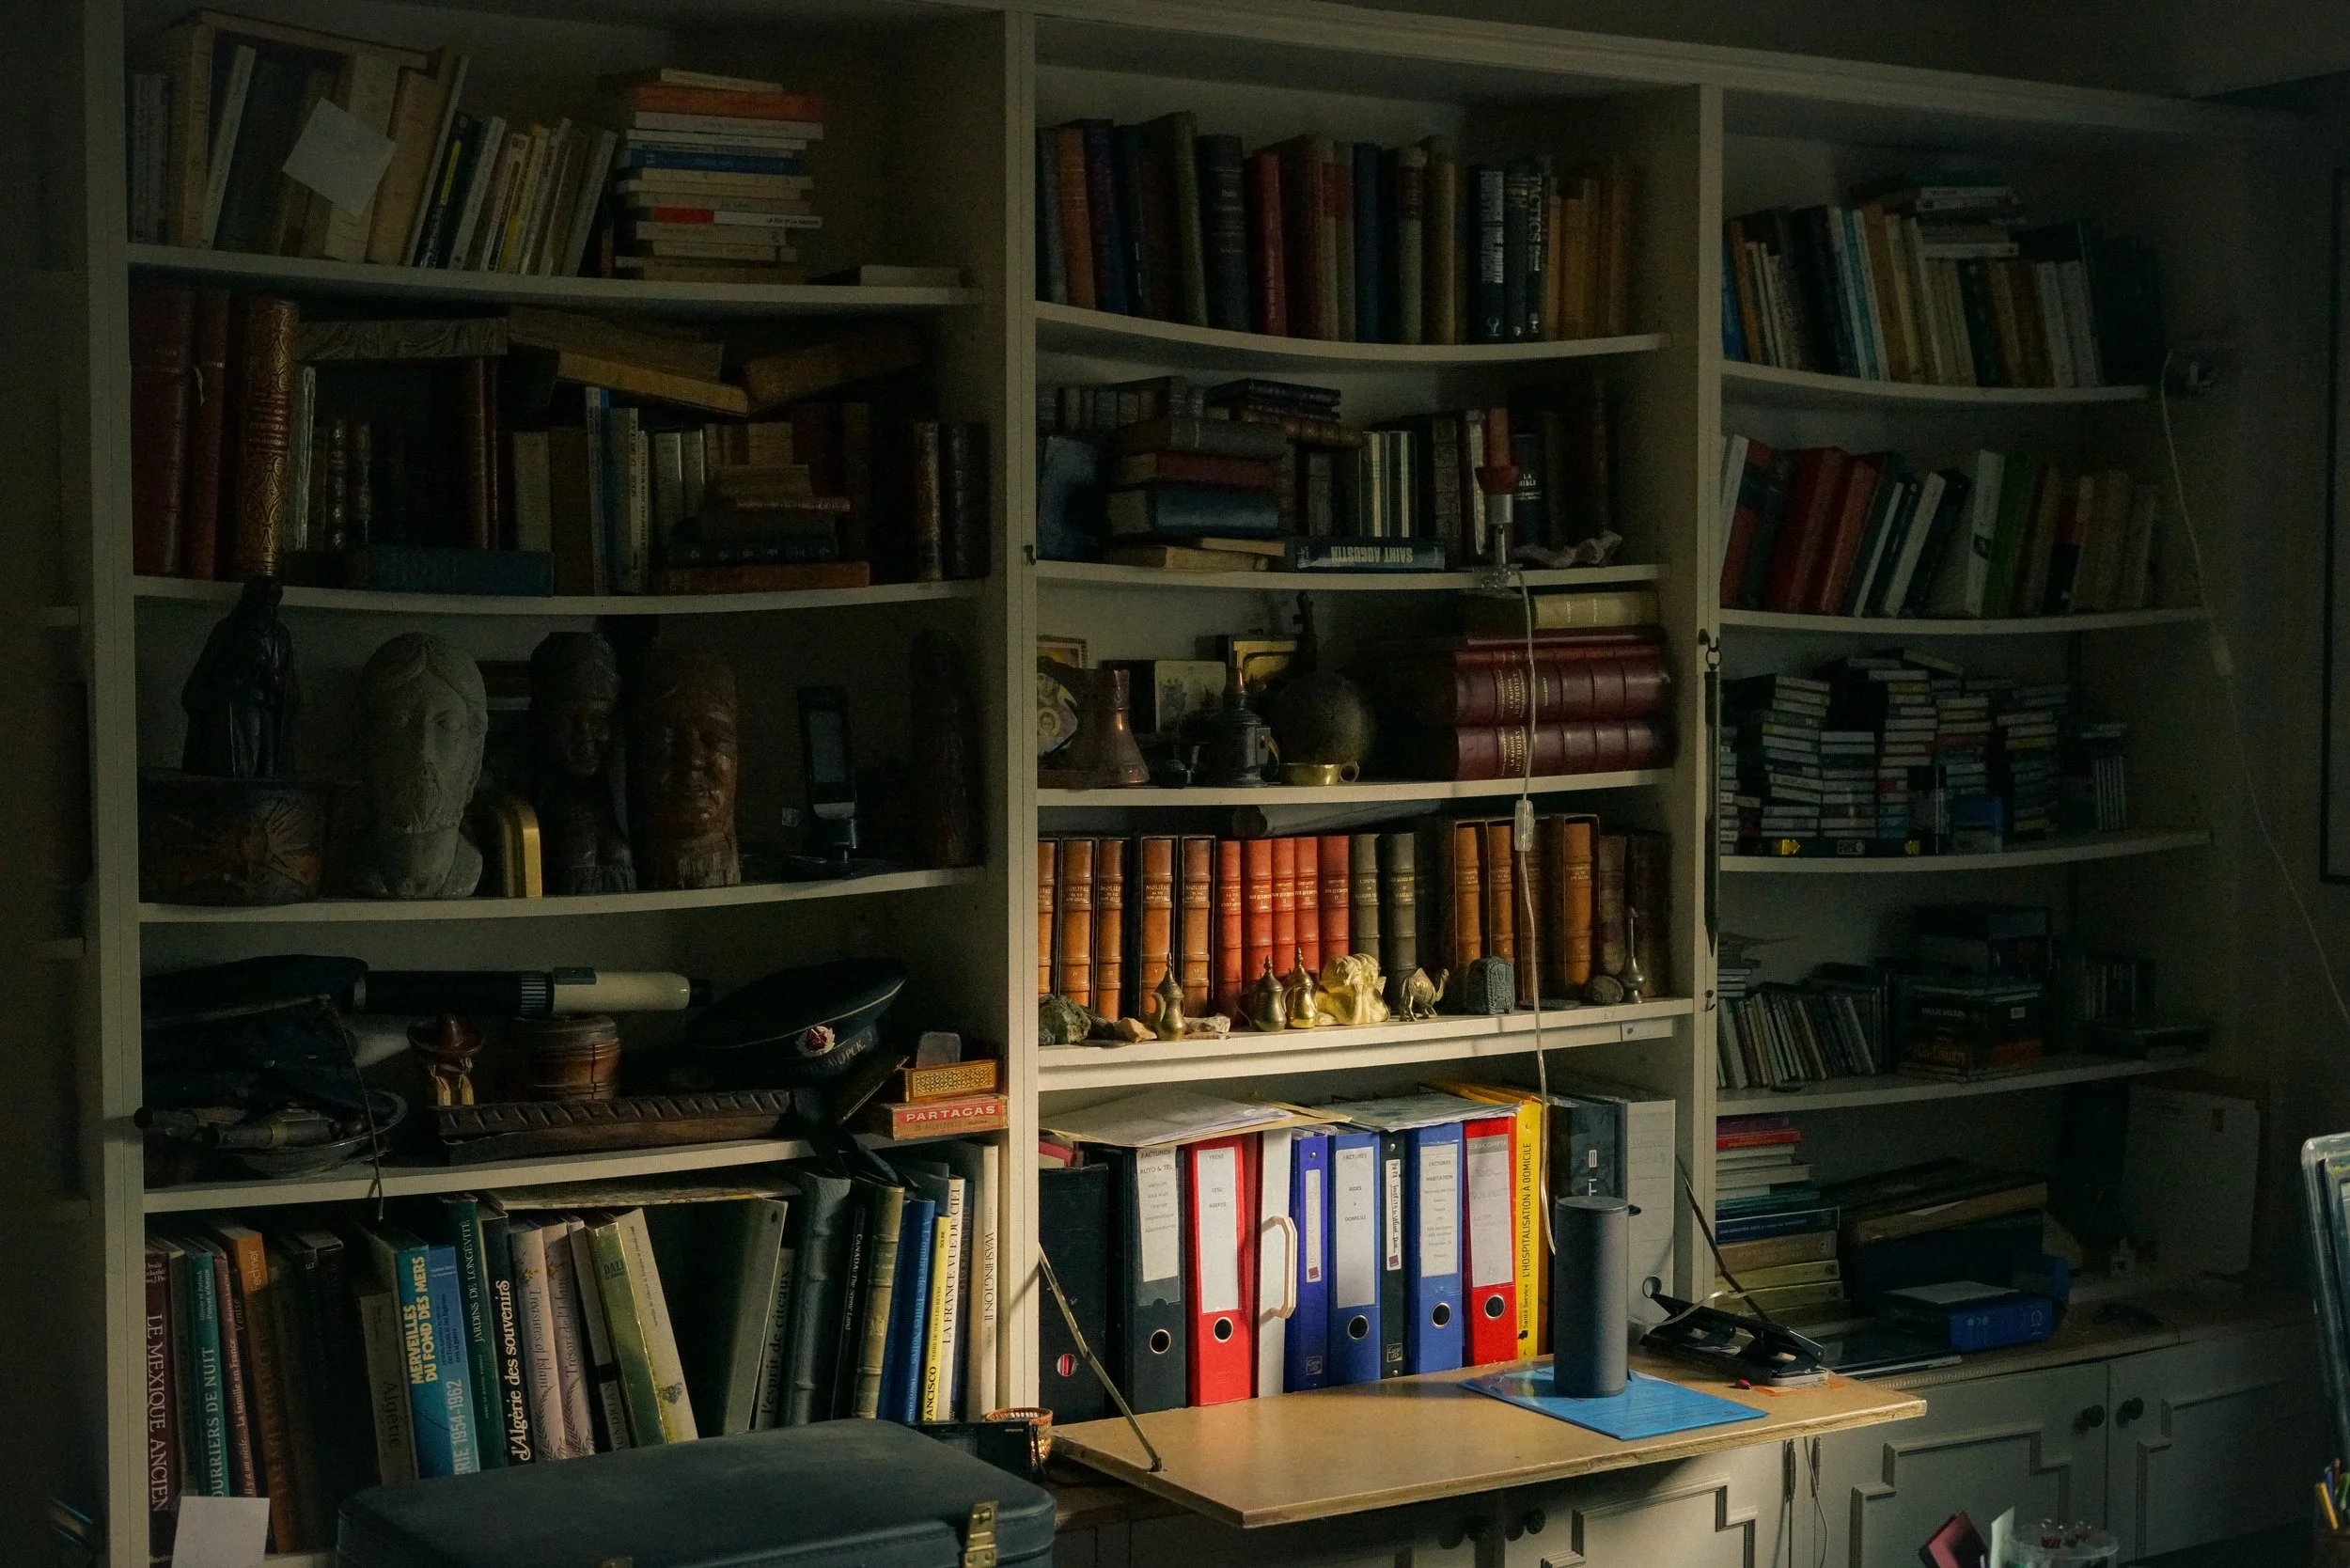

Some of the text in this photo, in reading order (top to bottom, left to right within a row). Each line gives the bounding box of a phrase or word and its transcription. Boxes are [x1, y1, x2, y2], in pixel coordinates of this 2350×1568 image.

[1528, 173, 1542, 243] TACTICS
[1330, 546, 1414, 563] SAINT AUGUSTIN
[906, 1105, 996, 1122] PARTAGAS
[1141, 1150, 1171, 1158] FACTURES
[1521, 1143, 1531, 1183] DOMICILE
[918, 1230, 932, 1272] L'ombre
[1521, 1194, 1531, 1278] L'HOSPITALISATION
[461, 1220, 486, 1343] JARDINS DE LONGÉVITÉ
[850, 1275, 858, 1288] The
[941, 1184, 961, 1344] LA FRANCE VUE DU CIEL
[983, 1232, 995, 1311] WASHINGTON
[847, 1289, 855, 1311] Scenic
[916, 1277, 927, 1294] des
[233, 1298, 243, 1331] Venise
[412, 1256, 438, 1382] DU FOND DES MERS
[494, 1280, 518, 1356] souvenirs
[844, 1312, 854, 1331] Land
[913, 1294, 925, 1330] Tentes
[227, 1338, 239, 1369] France
[403, 1304, 425, 1385] MERVEILLES
[528, 1288, 552, 1388] Treasures of Islam
[769, 1333, 782, 1353] de
[909, 1332, 923, 1366] Noires
[201, 1346, 216, 1387] NUIT
[231, 1371, 241, 1381] en
[504, 1358, 520, 1386] des
[204, 1391, 218, 1412] DE
[231, 1383, 244, 1413] famille
[760, 1359, 781, 1414] l'esprit
[146, 1315, 169, 1513] LE MEXIQUE ANCIEN
[236, 1415, 245, 1427] La
[383, 1381, 405, 1449] Algérie
[446, 1379, 472, 1475] RIE 1954-1962
